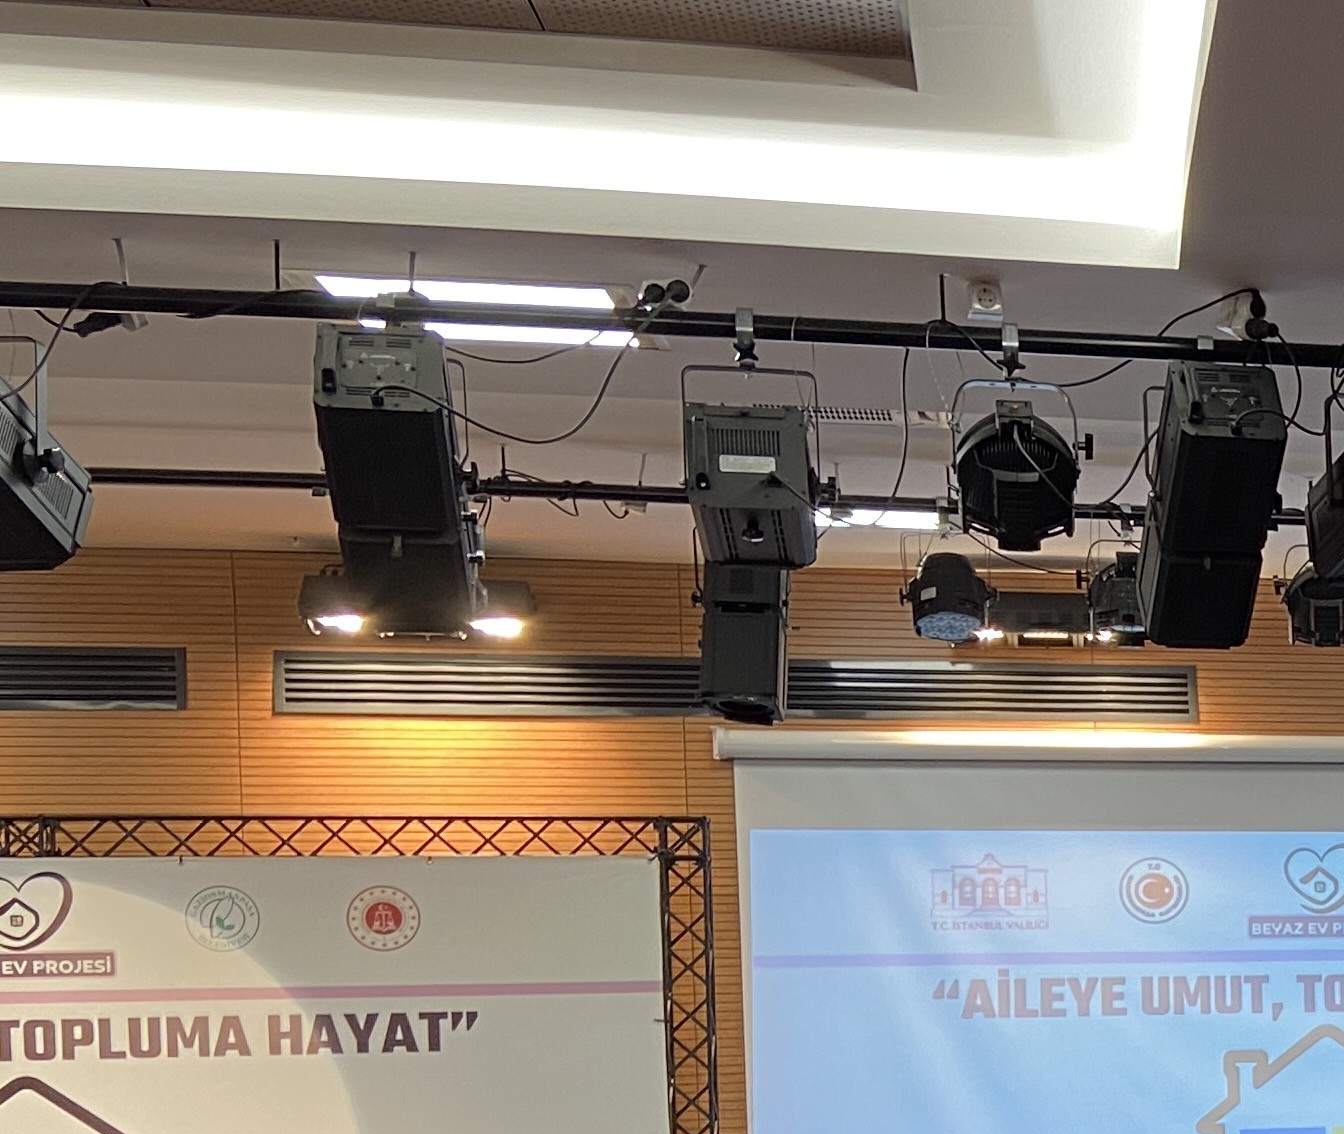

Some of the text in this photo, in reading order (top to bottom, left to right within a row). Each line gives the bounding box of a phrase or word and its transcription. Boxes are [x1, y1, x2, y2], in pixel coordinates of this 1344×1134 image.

[1252, 922, 1303, 935] BEYAZ
[1308, 922, 1329, 934] EV
[2, 956, 111, 974] EV PROJESİ
[1141, 974, 1284, 1021] UMUT,
